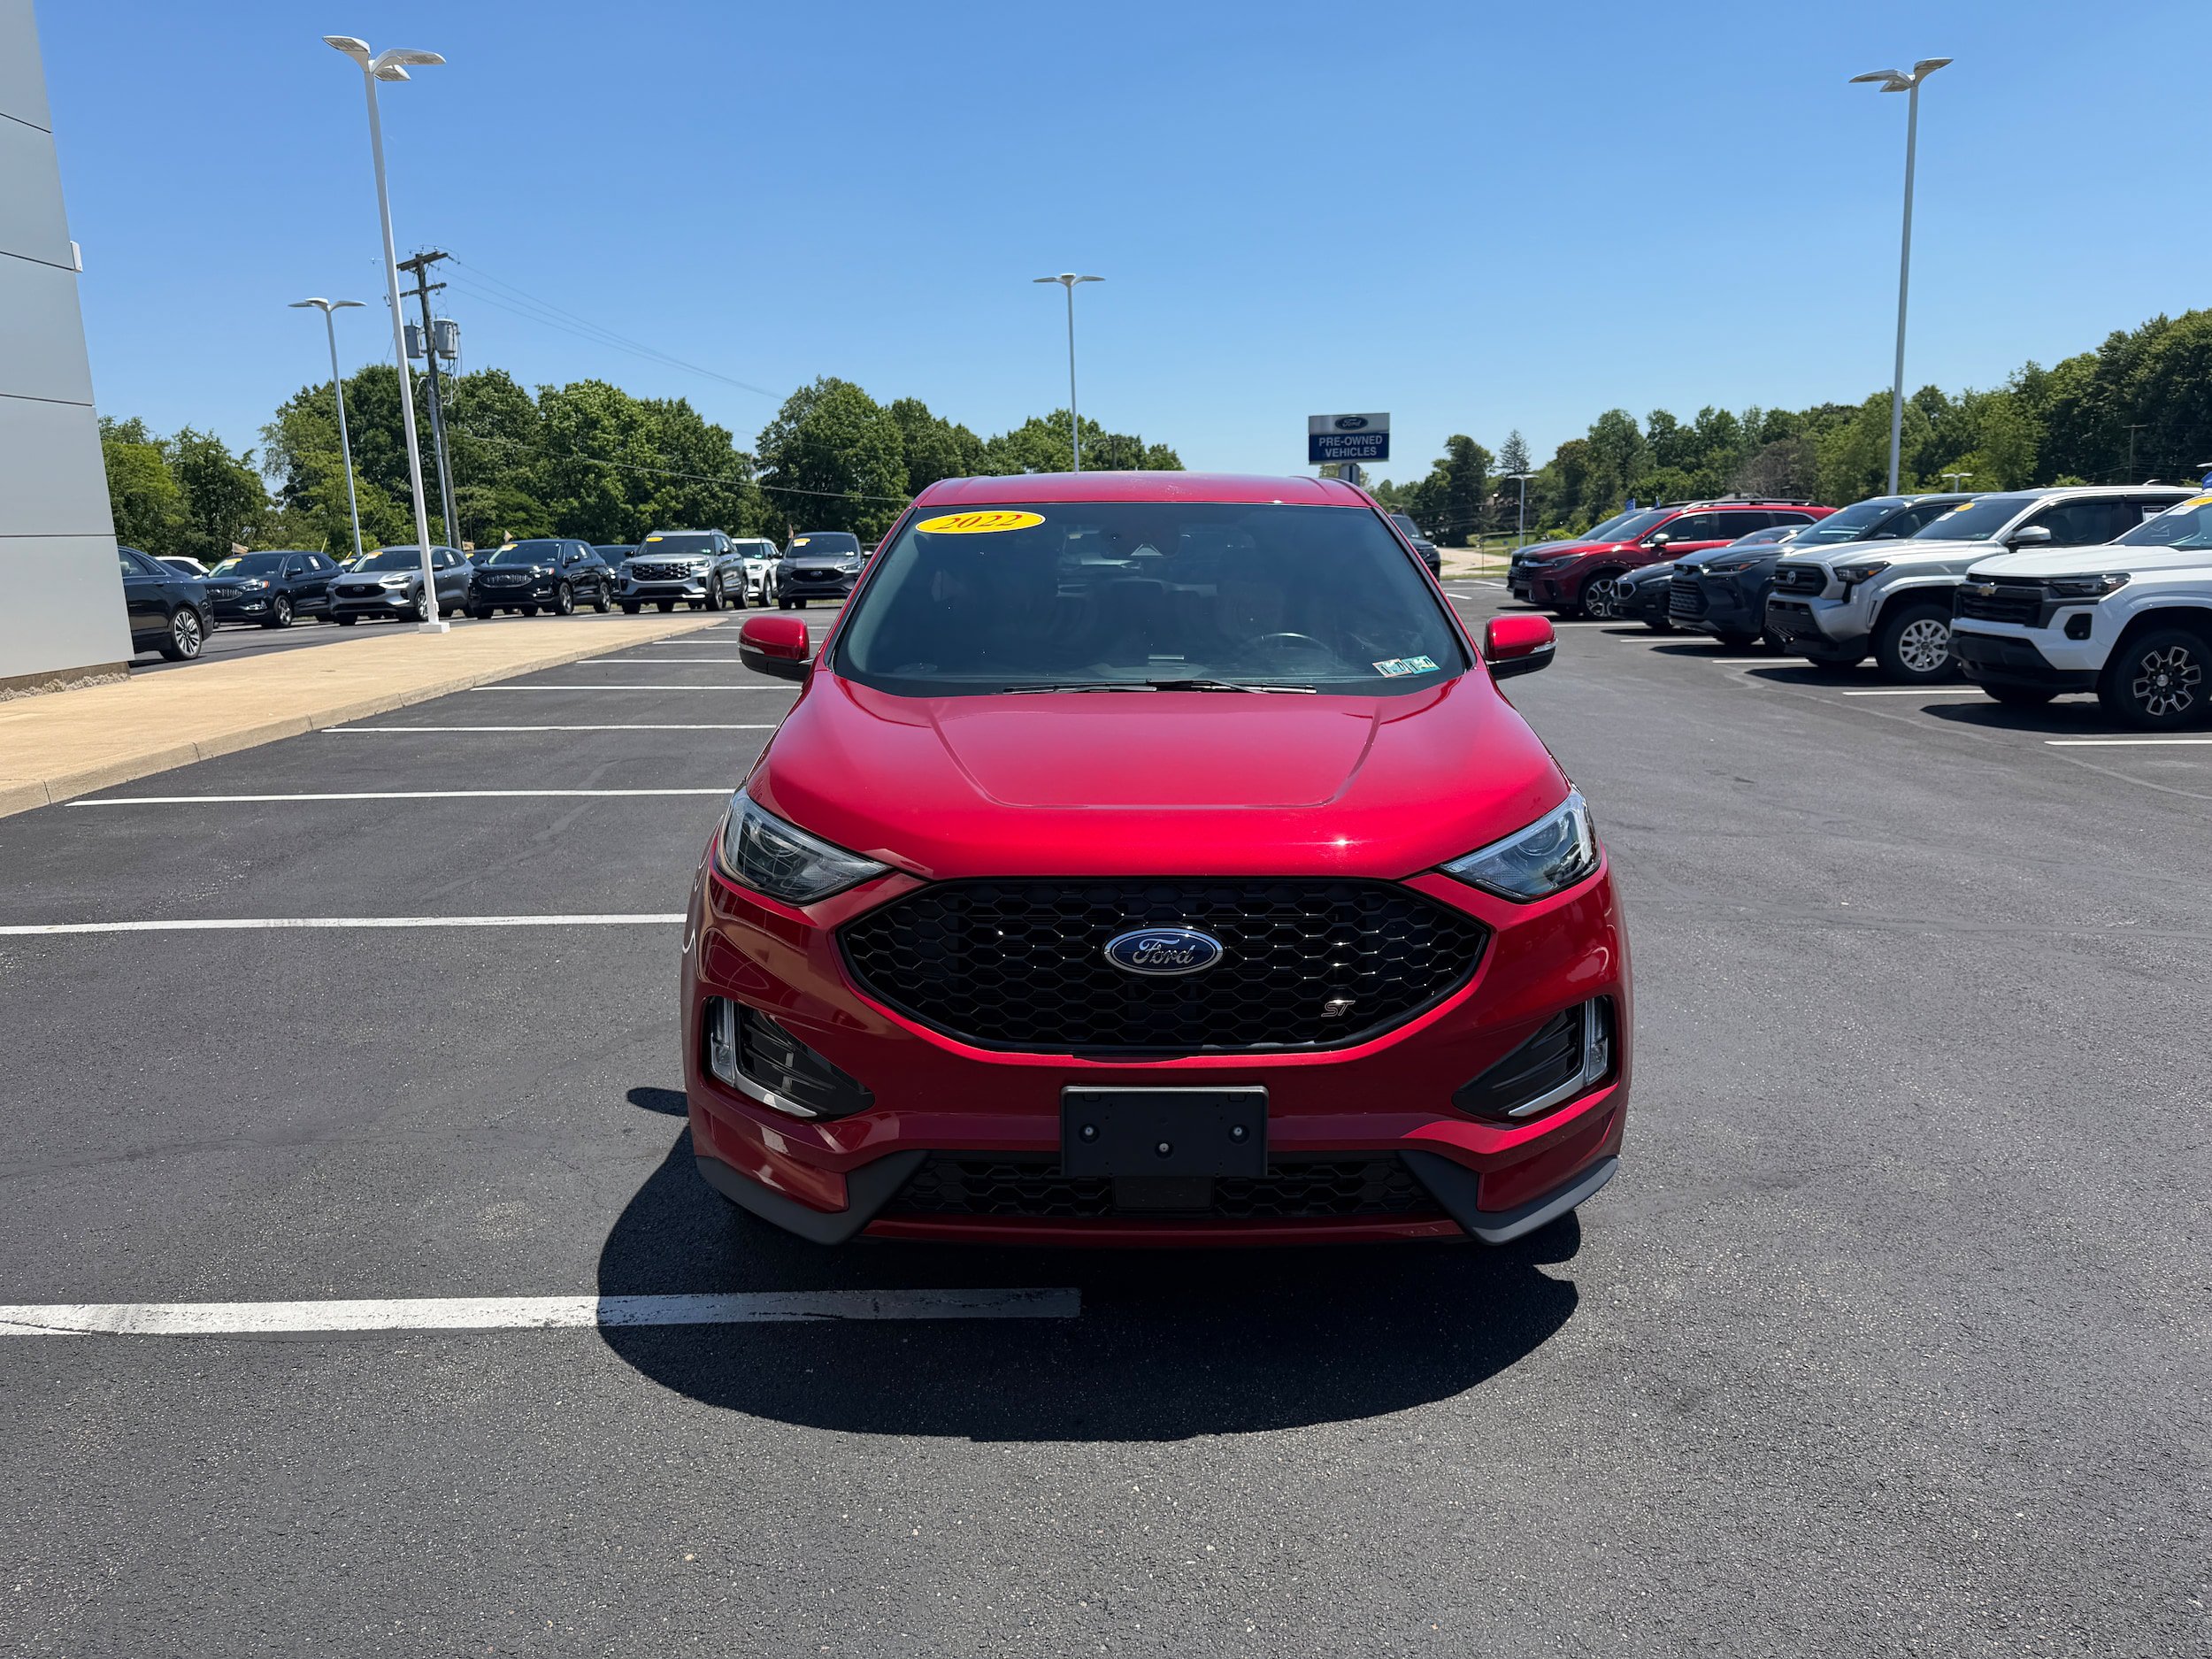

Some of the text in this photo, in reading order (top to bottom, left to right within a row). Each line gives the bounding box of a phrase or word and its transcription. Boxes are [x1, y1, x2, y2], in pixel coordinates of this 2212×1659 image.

[1318, 434, 1383, 447] PRE-OWNED
[1325, 446, 1377, 457] VEHICLES
[933, 514, 1023, 530] 2022
[1133, 938, 1196, 964] Ford
[1320, 999, 1356, 1018] ST
